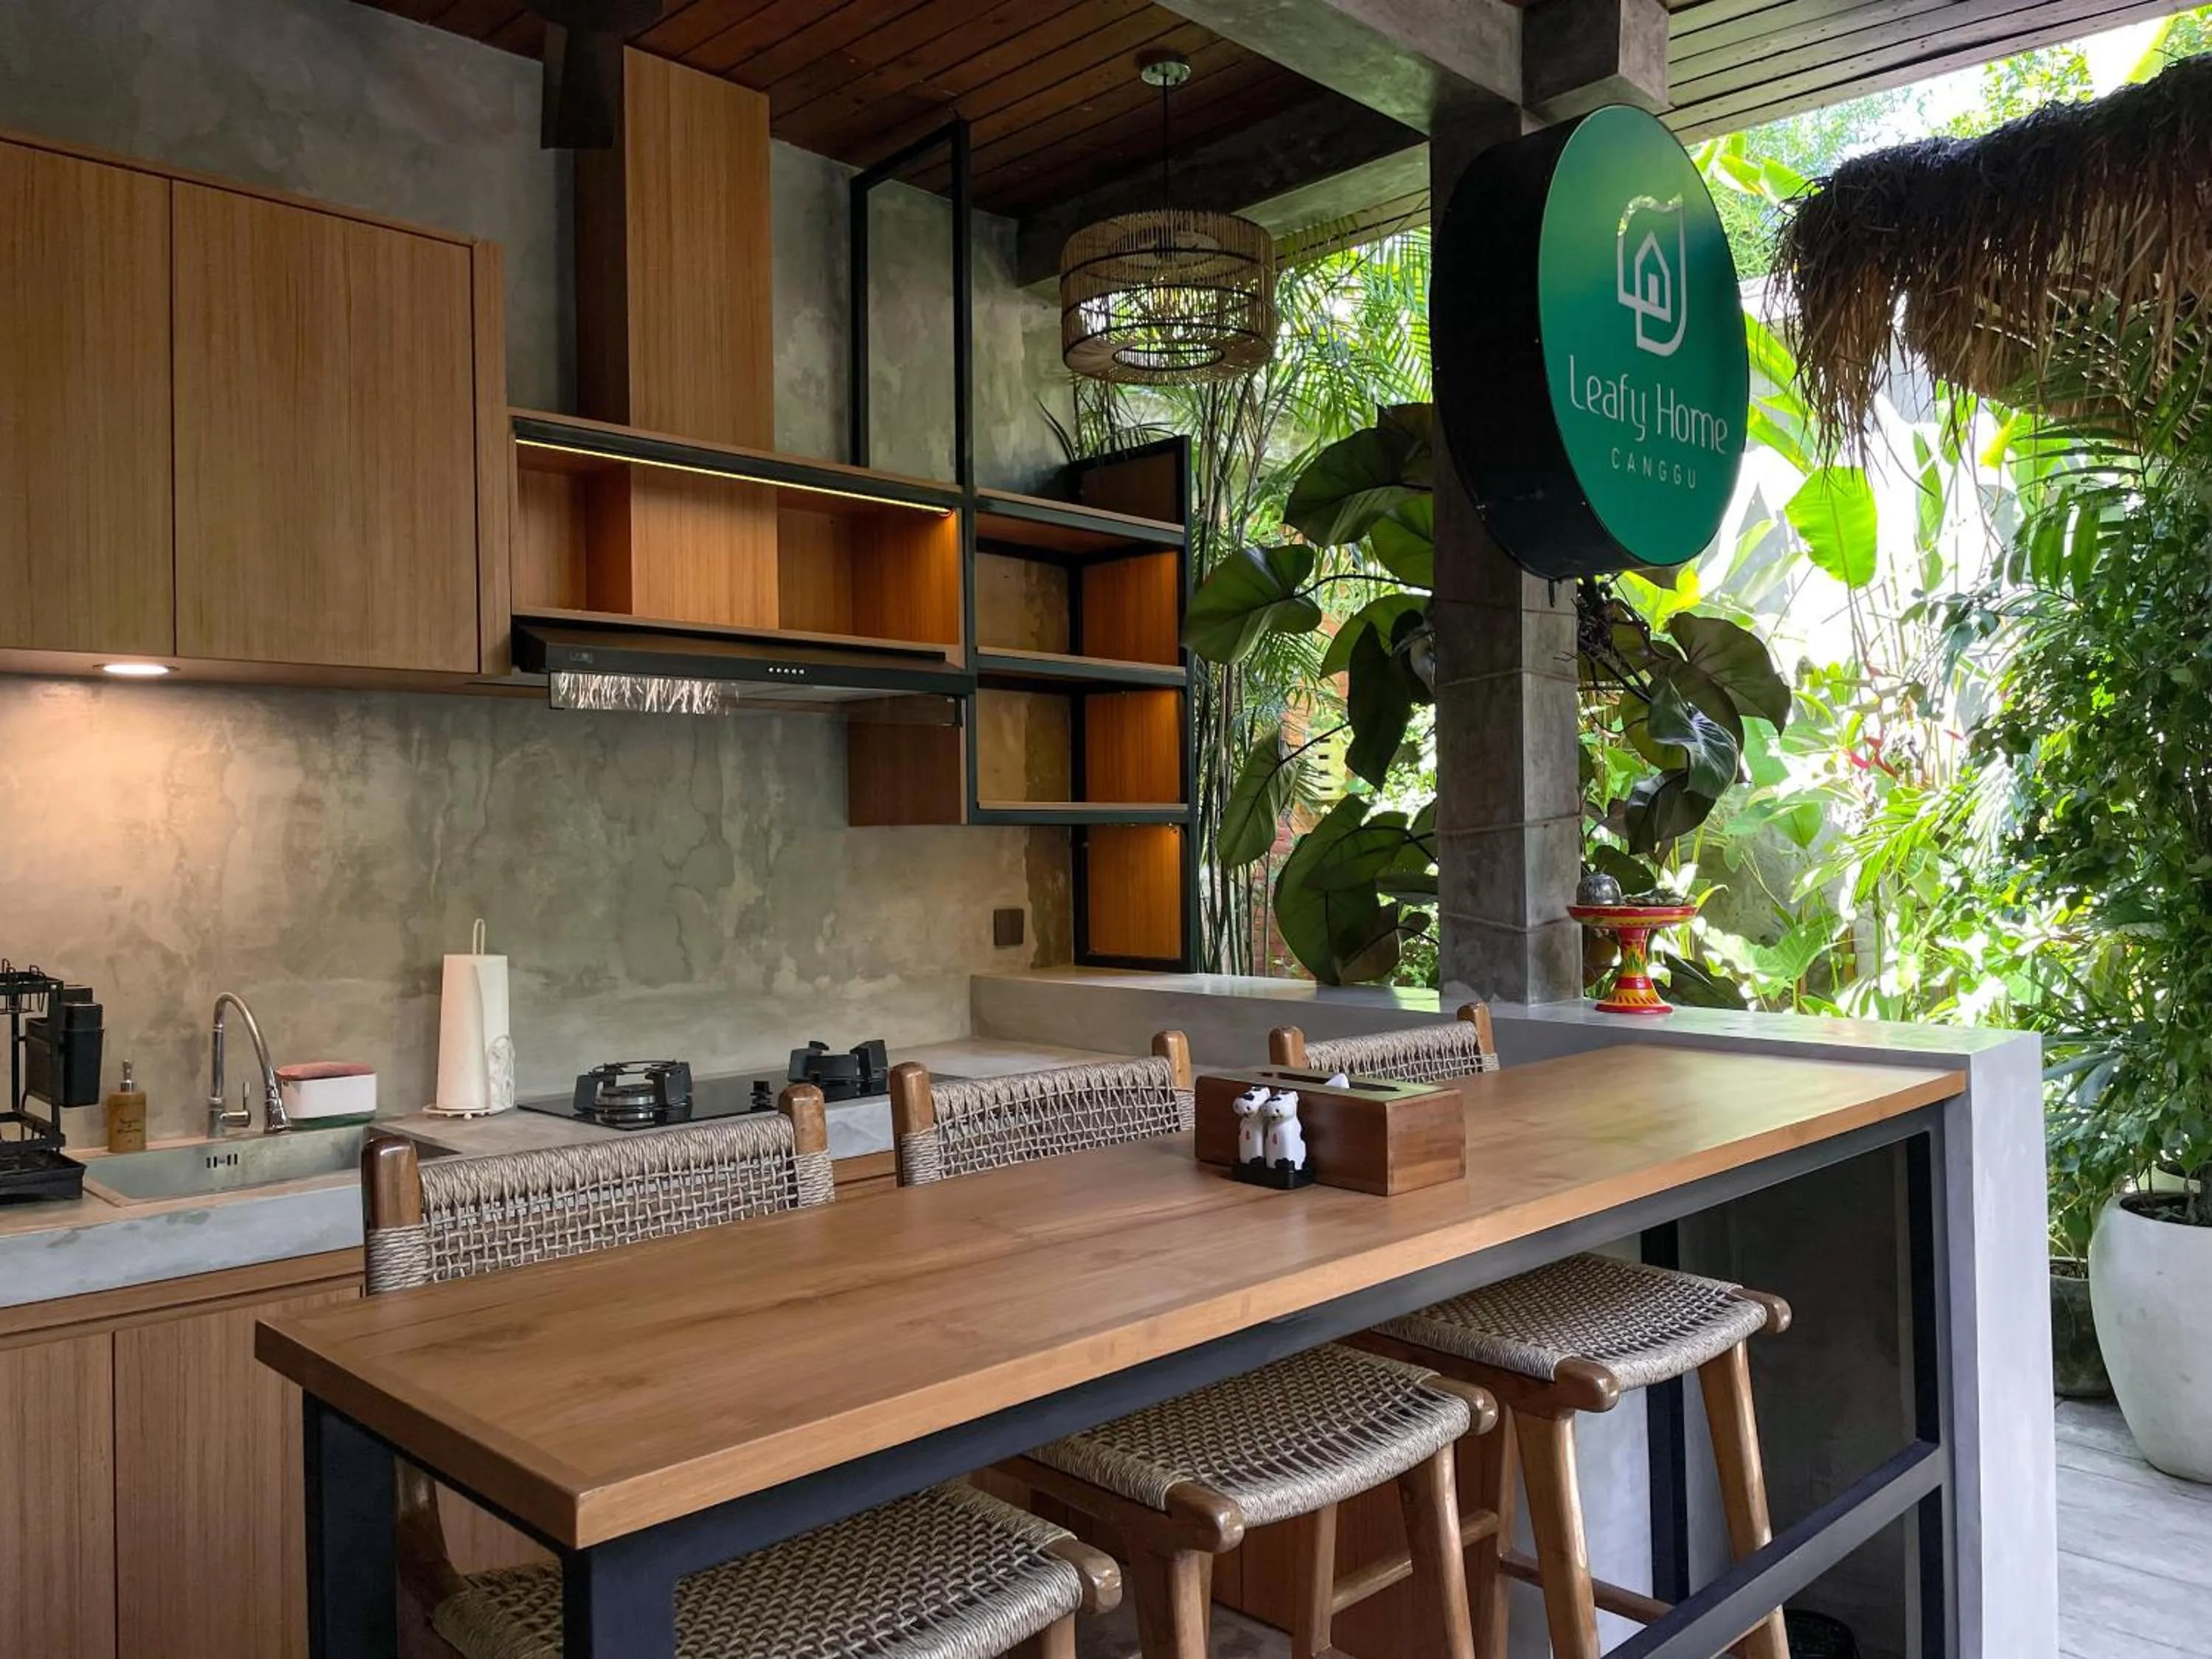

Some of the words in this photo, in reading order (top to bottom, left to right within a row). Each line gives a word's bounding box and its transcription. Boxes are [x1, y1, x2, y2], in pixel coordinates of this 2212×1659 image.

[1569, 354, 1646, 442] Leafy
[1656, 383, 1728, 455] Home
[1611, 447, 1696, 489] CANGGU
